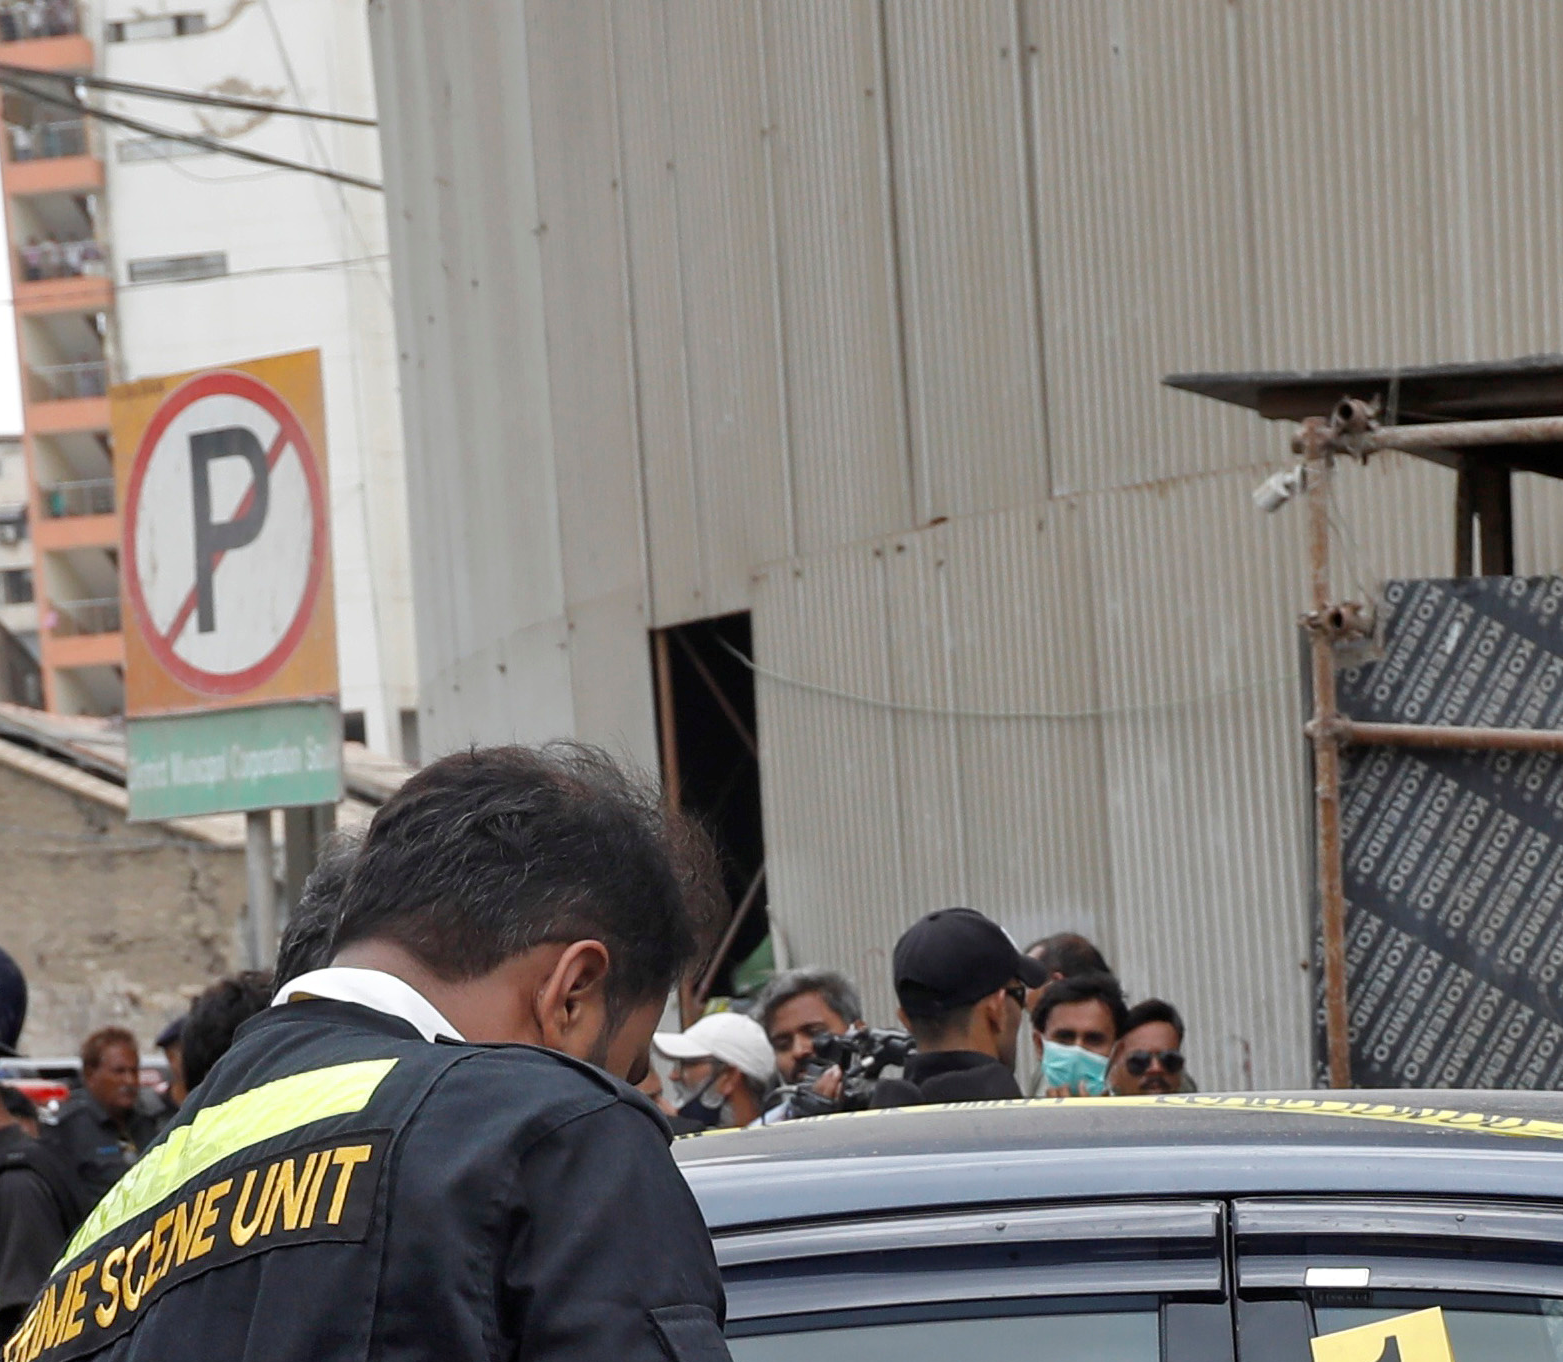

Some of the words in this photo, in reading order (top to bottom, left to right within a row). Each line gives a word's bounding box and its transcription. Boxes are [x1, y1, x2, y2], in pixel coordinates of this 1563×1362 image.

[1370, 585, 1444, 702] KOREMDO
[1401, 603, 1475, 719] KEMDO
[1476, 638, 1536, 730] KOREM
[1356, 760, 1428, 874] KOREMDO
[1386, 778, 1458, 892] KOREMDO
[1416, 795, 1489, 910] KOREMDO
[1446, 813, 1519, 928] KOREMDO
[1477, 831, 1550, 947] KOREMDO
[1371, 950, 1442, 1062] KOREMDO
[1401, 968, 1472, 1080] KOREMDO
[1435, 986, 1502, 1092] KOREMD
[1474, 1004, 1533, 1094] KOREM
[1518, 1023, 1563, 1091] KORE
[94, 1178, 235, 1329] SCENE
[229, 1144, 373, 1248] UNIT
